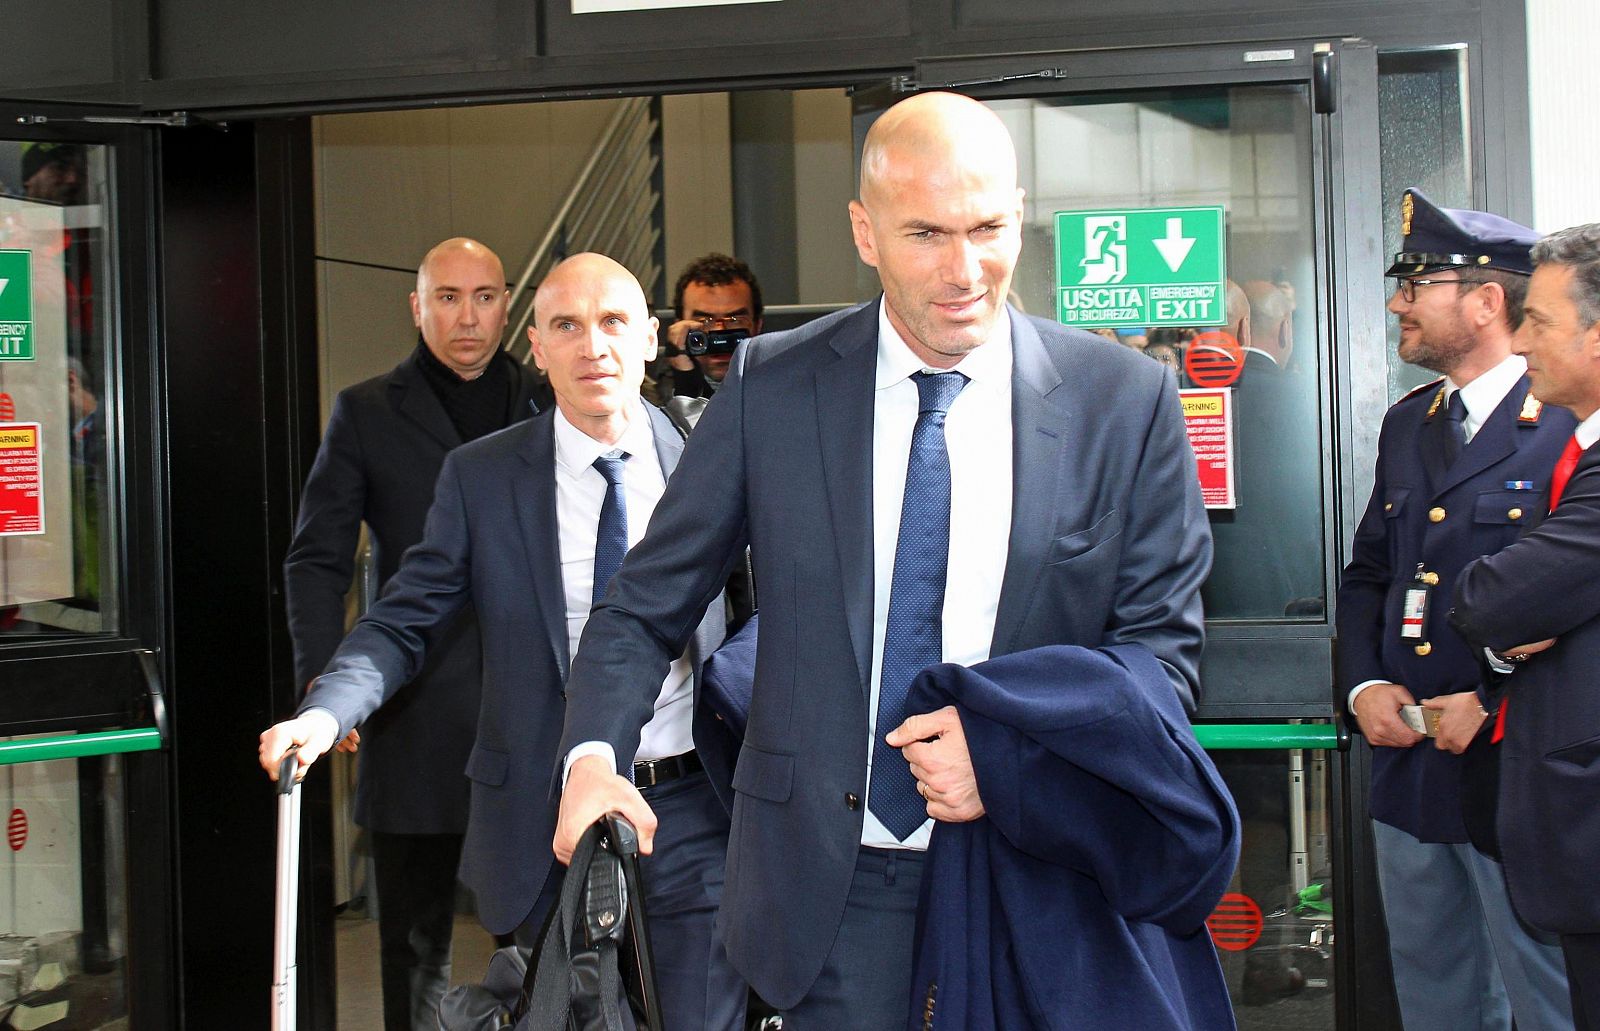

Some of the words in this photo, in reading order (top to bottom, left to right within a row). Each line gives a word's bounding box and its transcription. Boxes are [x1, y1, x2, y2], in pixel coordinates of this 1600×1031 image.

[1063, 288, 1143, 309] USCITA
[1151, 286, 1217, 299] EMERGENCY
[1066, 310, 1079, 322] DI
[1080, 308, 1140, 321] SICUREZZA
[1156, 299, 1213, 320] EXIT
[0, 337, 24, 354] IT
[1182, 402, 1217, 412] ARNING
